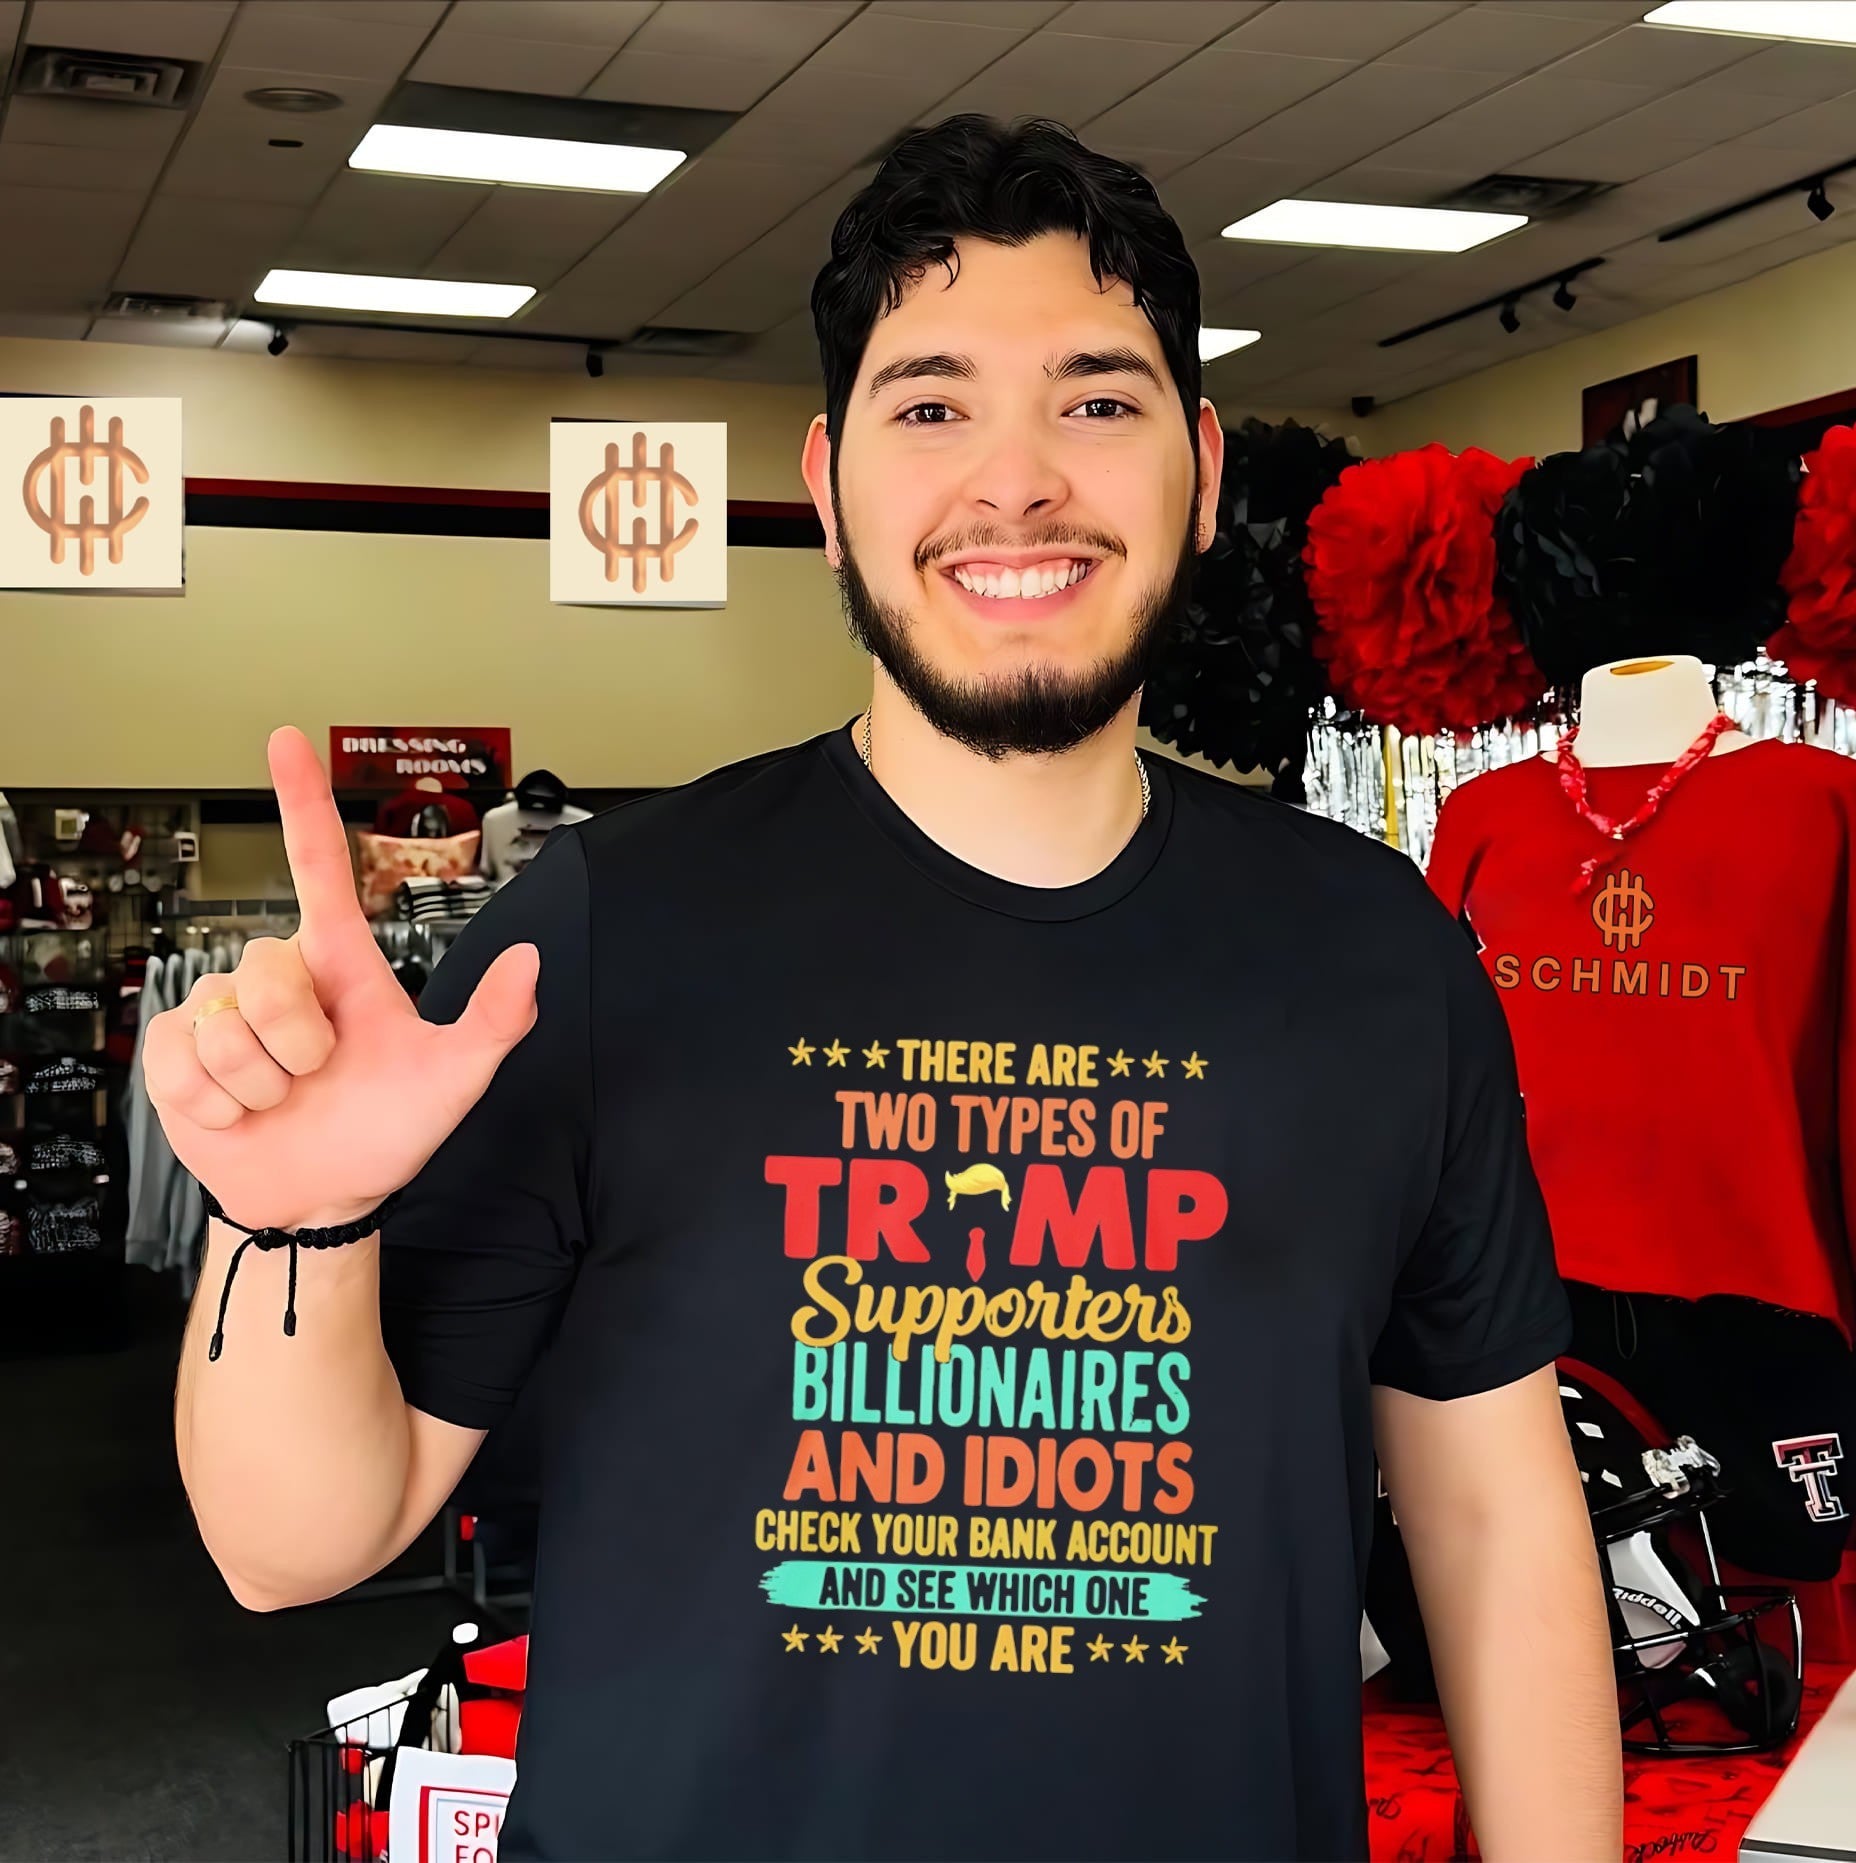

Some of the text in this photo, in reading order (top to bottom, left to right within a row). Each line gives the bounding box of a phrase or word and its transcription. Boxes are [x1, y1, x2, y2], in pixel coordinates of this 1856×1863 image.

[342, 737, 466, 753] DRESSING
[396, 759, 487, 774] ROOMS
[1494, 954, 1747, 1000] SCHMIDT
[898, 1039, 1099, 1087] THERE ARE
[835, 1091, 1168, 1159] TWO TYPES OF
[764, 1155, 1229, 1271] TRMP
[791, 1255, 1192, 1363] Supporters
[792, 1341, 1191, 1435] BILLIONAIRES
[782, 1429, 1194, 1514] AND IDIOTS
[755, 1508, 1218, 1566] CHECK YOUR BANK ACCOUNT
[819, 1566, 1150, 1617] AND SEE WHICH ONE
[892, 1621, 1074, 1673] YOU ARE
